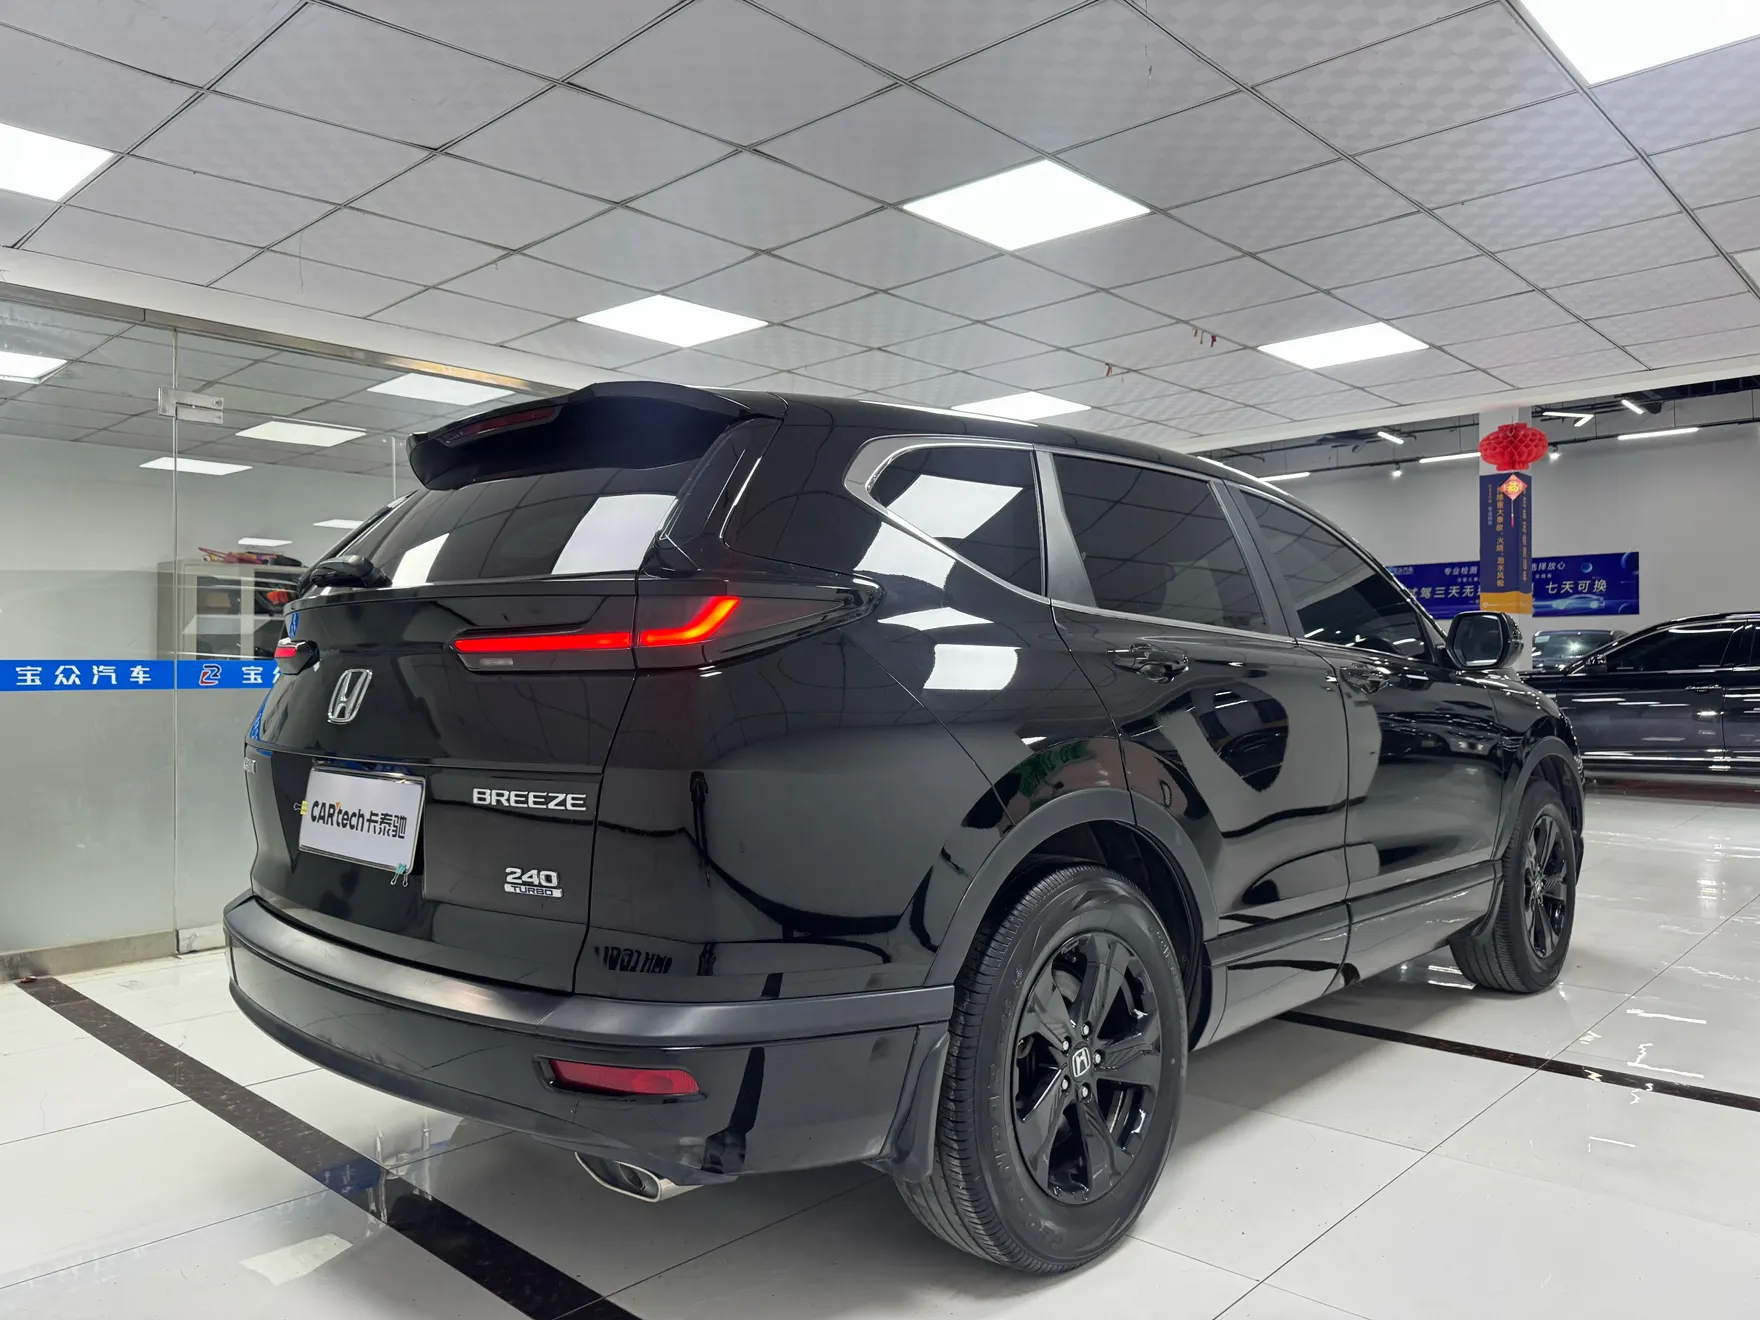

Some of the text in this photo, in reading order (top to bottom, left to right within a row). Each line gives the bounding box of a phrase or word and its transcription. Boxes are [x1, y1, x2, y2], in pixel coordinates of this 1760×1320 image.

[1444, 565, 1478, 576] 专业检测
[1408, 585, 1480, 599] 试驾三天无
[1545, 578, 1607, 595] 七天可换
[15, 665, 152, 686] 宝众汽车
[472, 787, 587, 811] BREEZE
[505, 867, 558, 887] 240
[510, 885, 554, 897] TURBO
